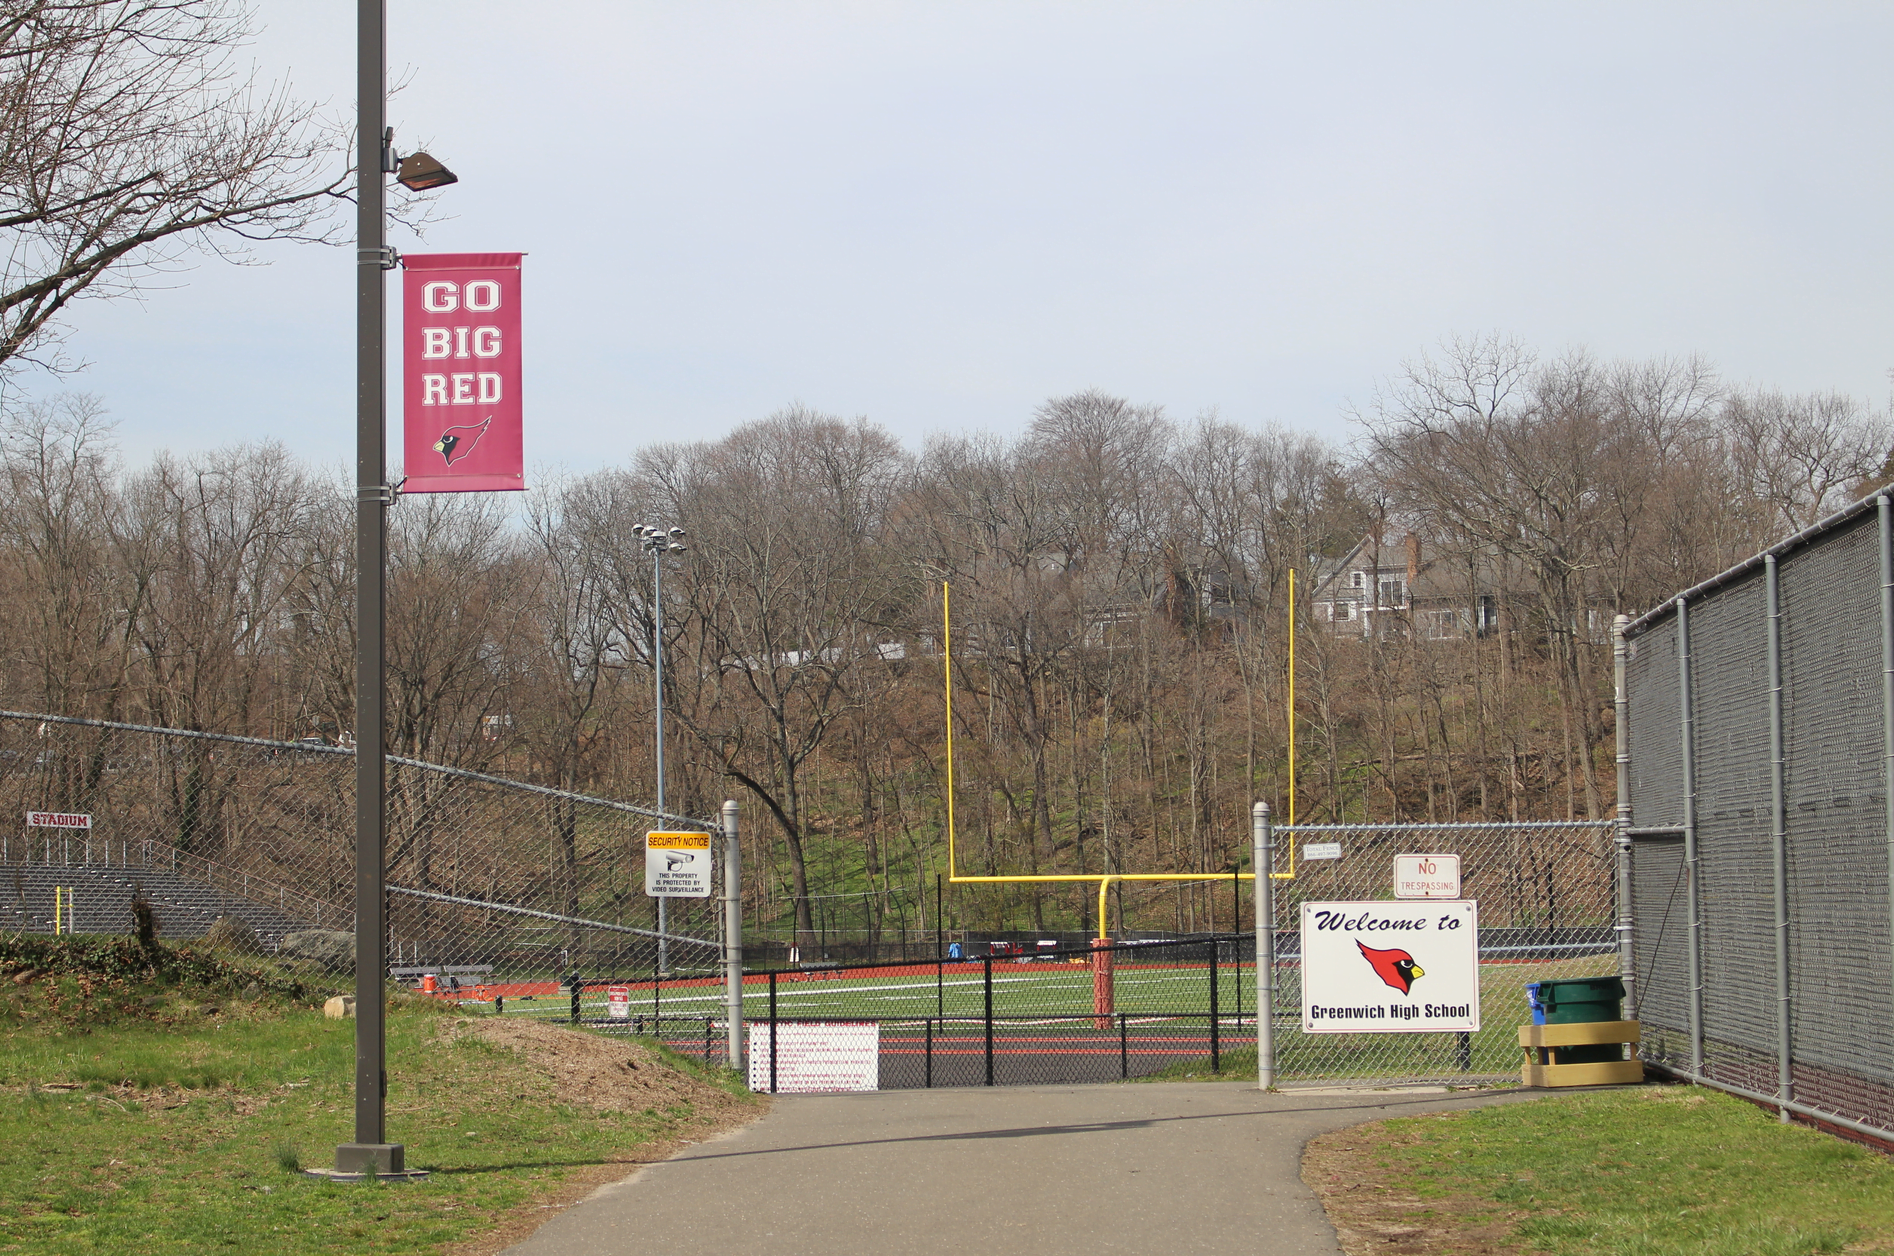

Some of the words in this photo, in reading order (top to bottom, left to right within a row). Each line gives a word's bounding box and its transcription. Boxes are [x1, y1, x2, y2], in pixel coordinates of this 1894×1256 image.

[422, 279, 502, 314] GO
[422, 325, 502, 360] BIG
[422, 372, 503, 406] RED
[33, 813, 88, 827] STADIUM
[648, 836, 682, 846] SECURITY
[683, 837, 709, 847] NOTICE
[1418, 862, 1437, 875] NO
[1400, 881, 1454, 891] TRESPASSING
[1315, 910, 1428, 931] Welcome
[1437, 914, 1463, 931] to
[1311, 1004, 1385, 1019] Greenwich
[1390, 1004, 1420, 1020] High
[1424, 1003, 1470, 1018] School
